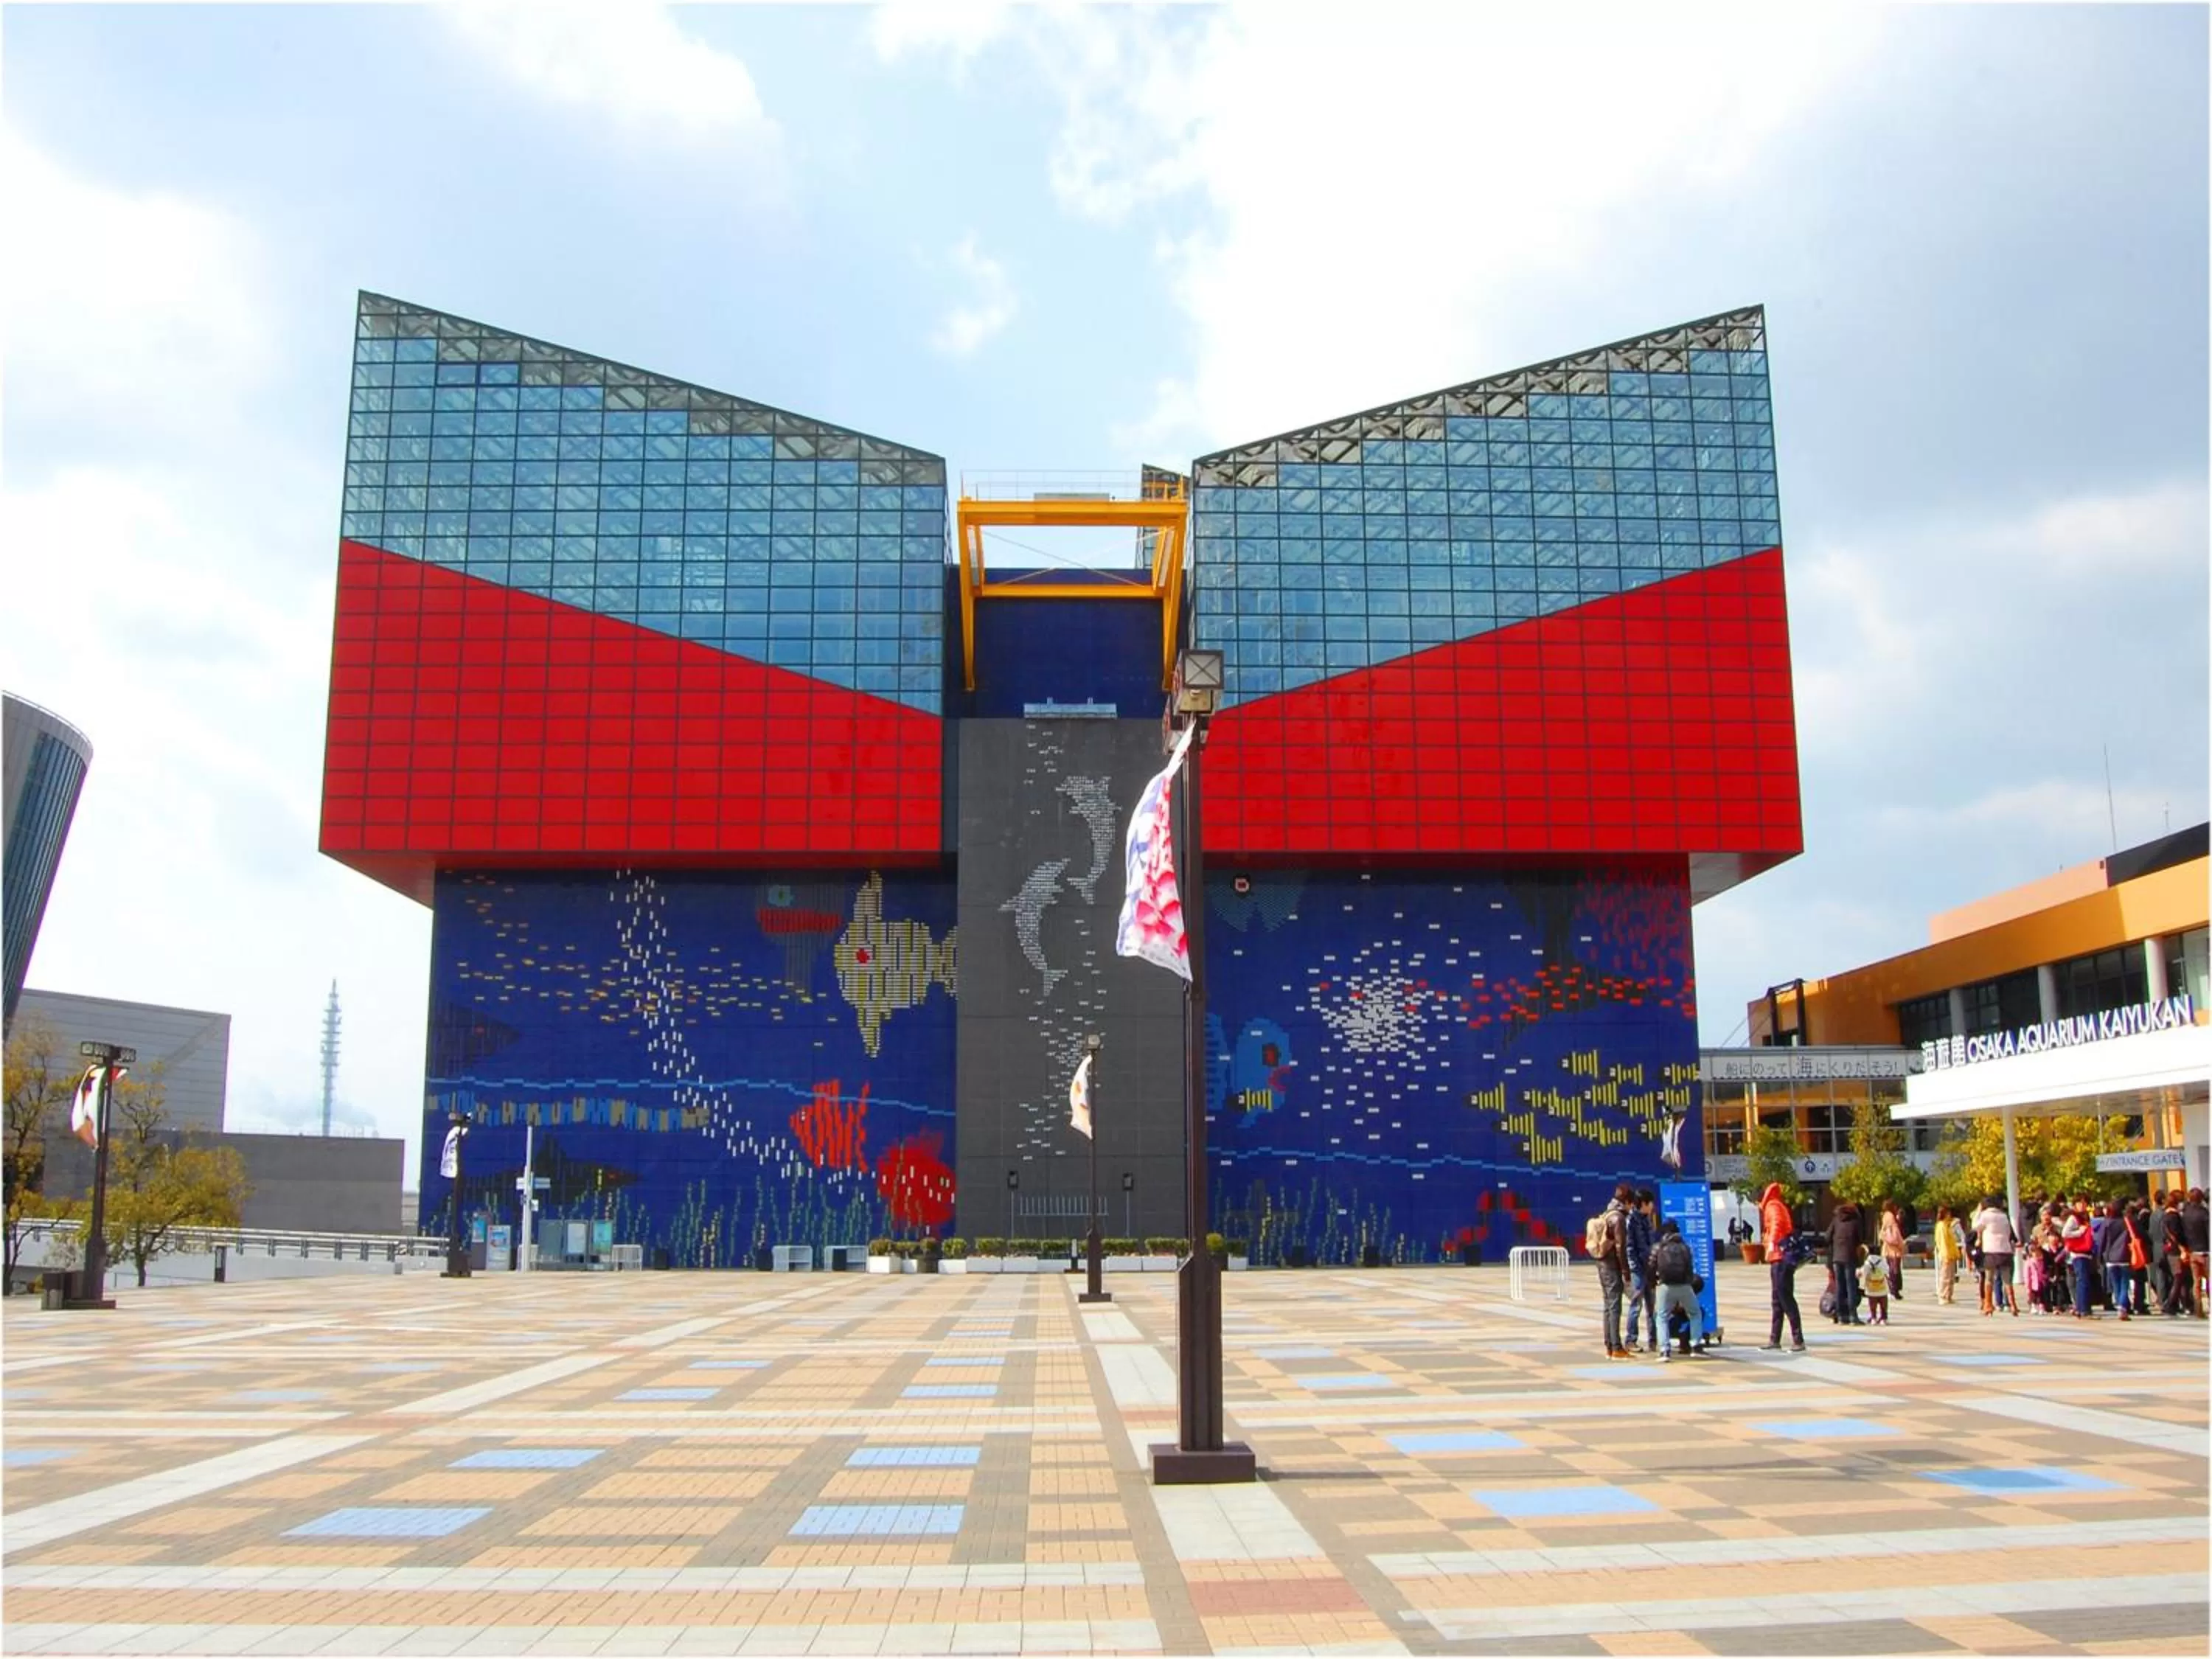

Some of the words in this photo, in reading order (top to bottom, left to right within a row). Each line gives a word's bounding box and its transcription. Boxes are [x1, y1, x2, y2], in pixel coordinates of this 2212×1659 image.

[1966, 1029, 2014, 1062] OSAKA
[2017, 1012, 2097, 1055] AQUARIUM
[2098, 993, 2191, 1039] KAIYUKAN
[2152, 1153, 2180, 1165] GATE
